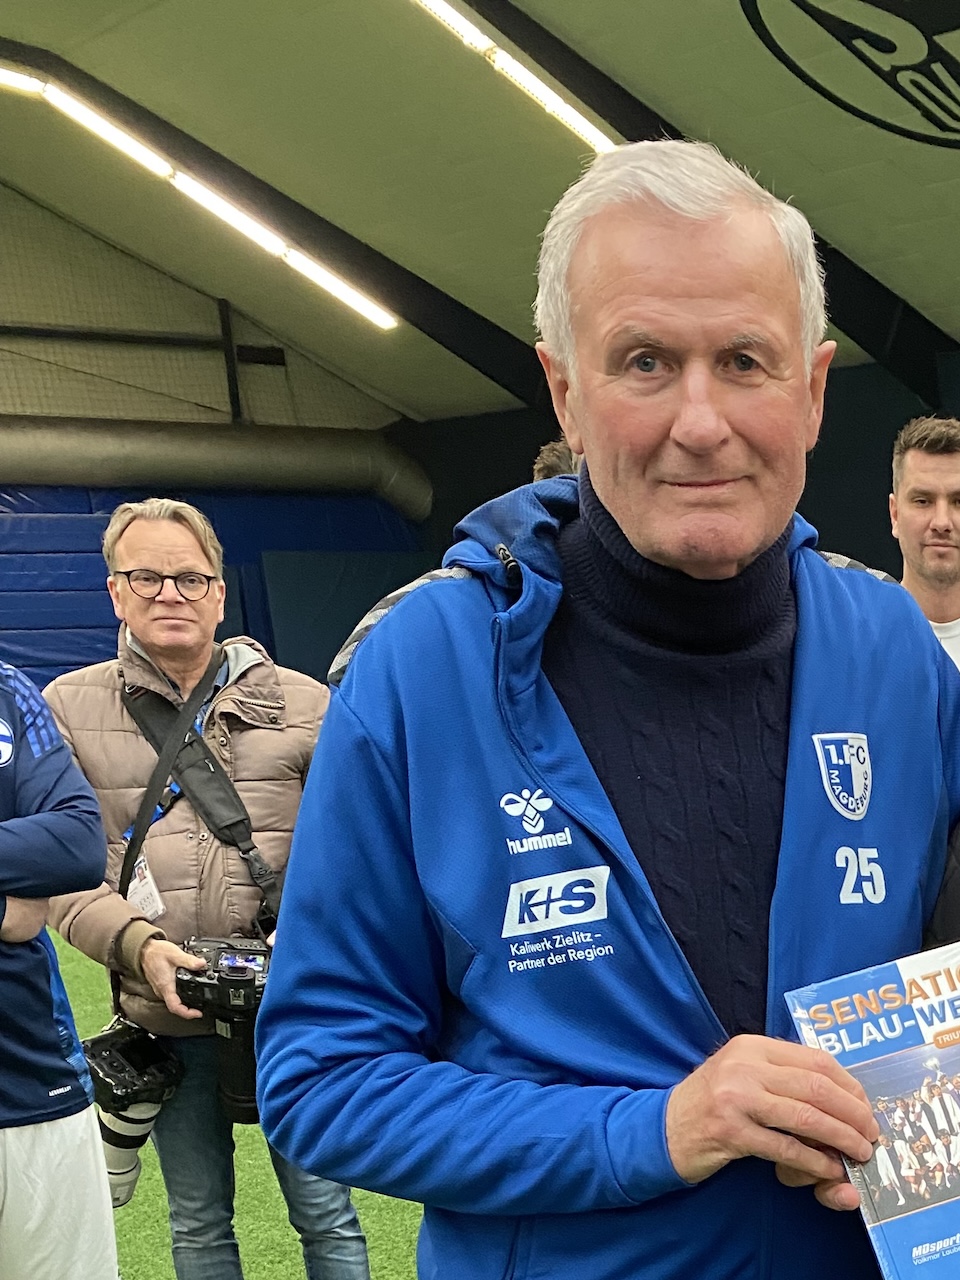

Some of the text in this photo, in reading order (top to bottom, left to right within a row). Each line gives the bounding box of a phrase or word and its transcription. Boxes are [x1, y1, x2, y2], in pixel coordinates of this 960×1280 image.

[829, 769, 868, 811] MAGDEBURG
[506, 827, 572, 855] hummel
[835, 846, 887, 904] 25
[508, 943, 614, 973] Partner der Region
[510, 938, 554, 956] Kaliwerk
[554, 931, 593, 949] Zielitz
[912, 1233, 960, 1258] MDsport
